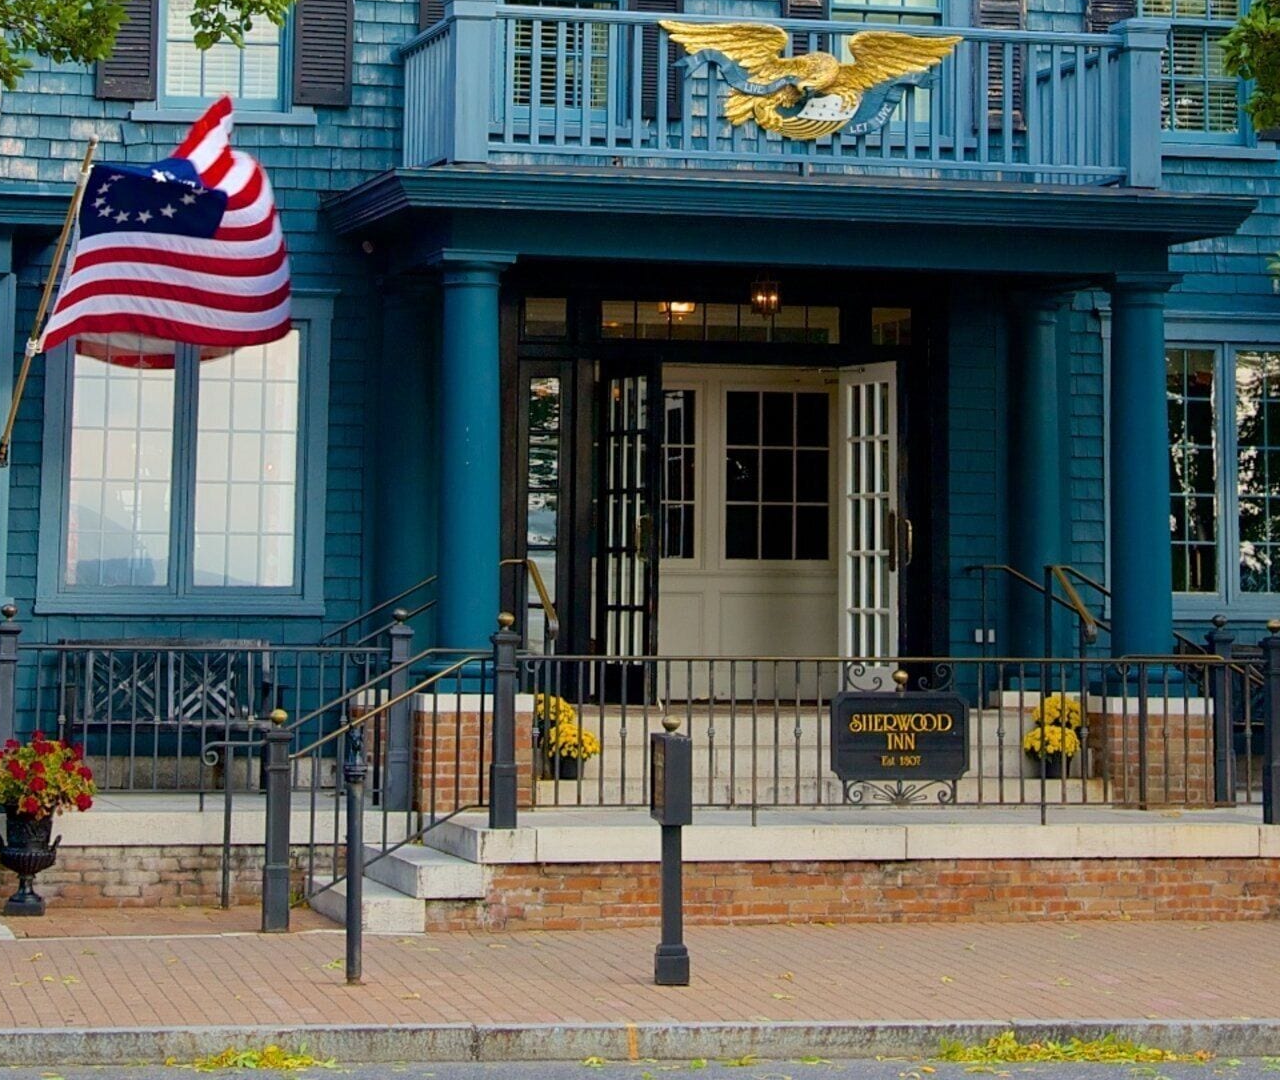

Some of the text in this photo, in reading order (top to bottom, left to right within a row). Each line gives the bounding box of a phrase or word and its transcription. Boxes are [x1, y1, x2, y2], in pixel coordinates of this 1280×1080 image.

[744, 82, 764, 94] LIVE
[850, 103, 892, 133] LET LIVE
[849, 713, 953, 733] SHERWOOD
[887, 733, 916, 751] INN
